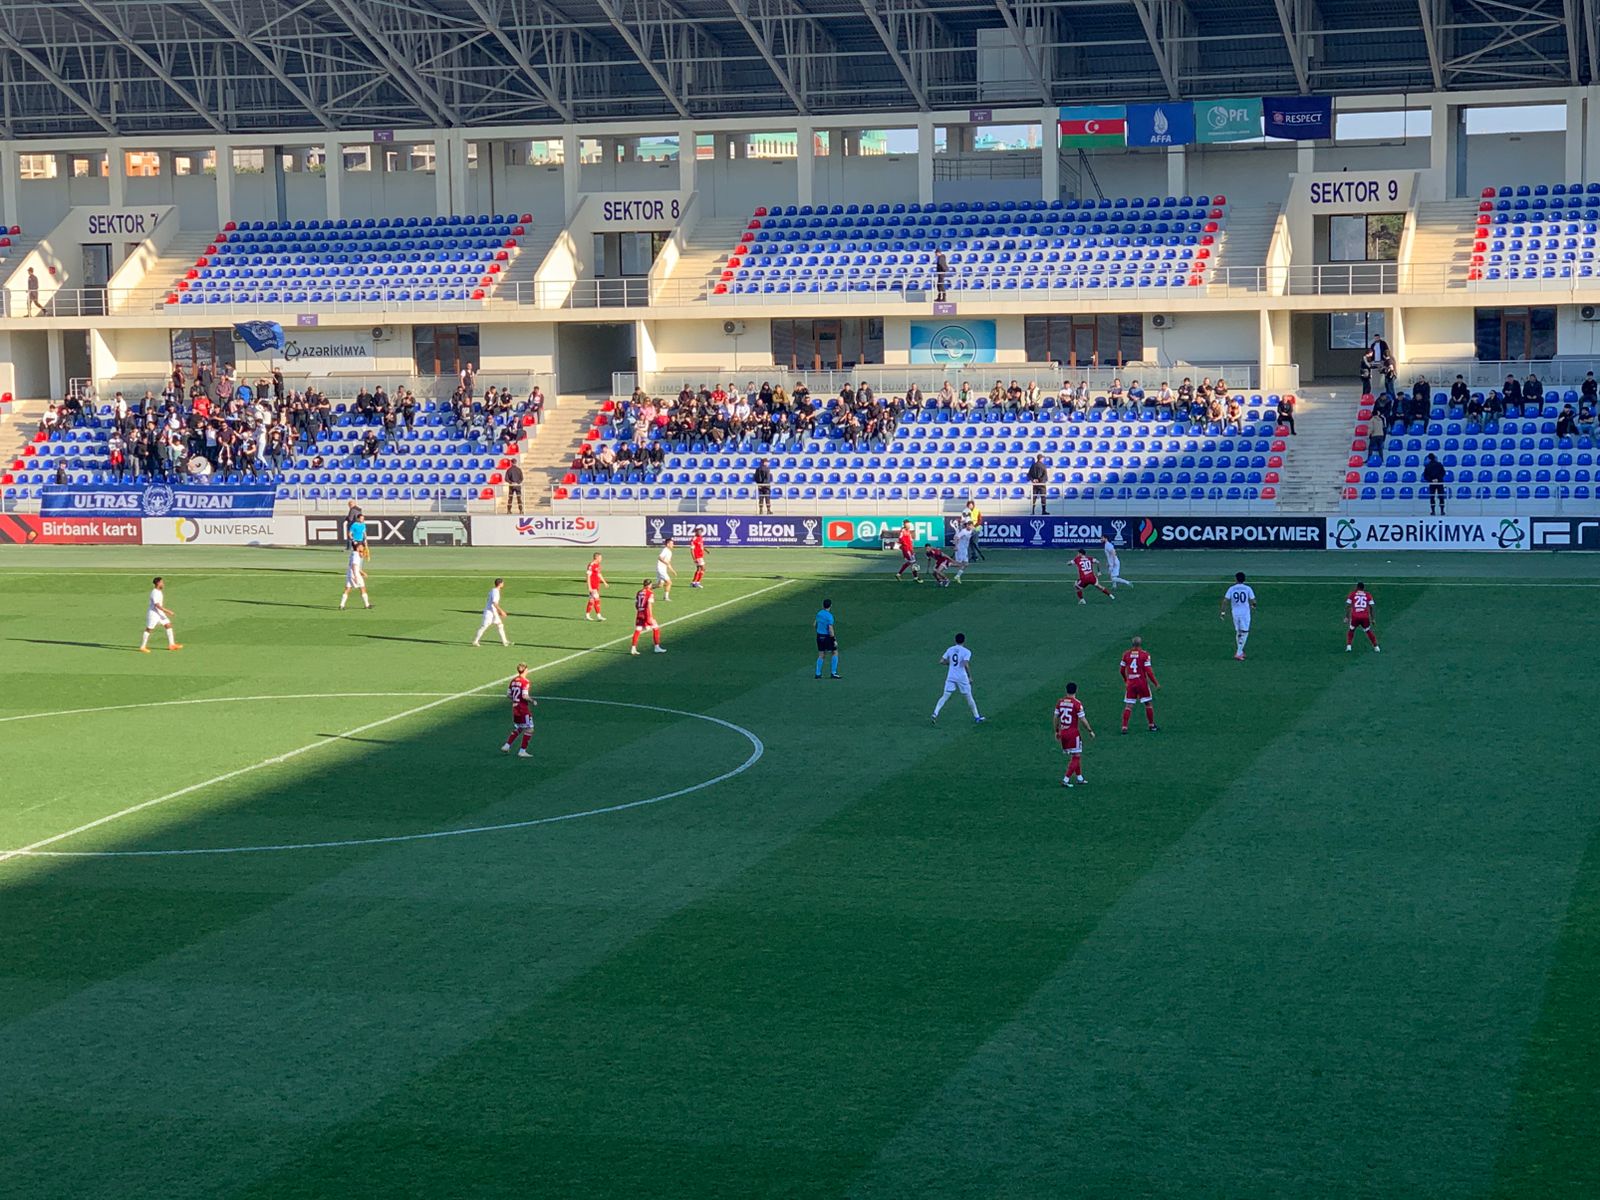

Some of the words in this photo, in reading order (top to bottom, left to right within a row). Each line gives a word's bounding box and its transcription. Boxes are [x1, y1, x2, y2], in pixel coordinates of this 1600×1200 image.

[1229, 108, 1250, 121] PFL
[1285, 113, 1322, 123] RESPECT
[1150, 134, 1172, 143] AFFA
[1310, 181, 1380, 204] SEKTOR
[1388, 180, 1398, 201] 9
[603, 200, 664, 221] SEKTOR
[671, 199, 680, 219] 8
[88, 214, 146, 234] SEKTOR
[150, 213, 159, 227] 7
[302, 344, 367, 357] AZƏRİKİMYA
[74, 494, 138, 508] ULTRAS
[175, 494, 233, 508] TURAN
[42, 521, 100, 536] Birbank
[204, 524, 274, 535] UNIVERSAL
[748, 520, 795, 537] BİZON
[1053, 521, 1103, 538] BİZON
[1161, 525, 1229, 541] SOCAR
[1230, 525, 1320, 541] POLYMER
[1365, 519, 1486, 543] AZƏRİKİMYA
[1079, 559, 1092, 571] 30
[1233, 591, 1247, 604] 90
[1354, 595, 1368, 608] 26
[952, 653, 959, 667] 9
[1129, 658, 1138, 673] 4
[1059, 707, 1073, 725] 25
